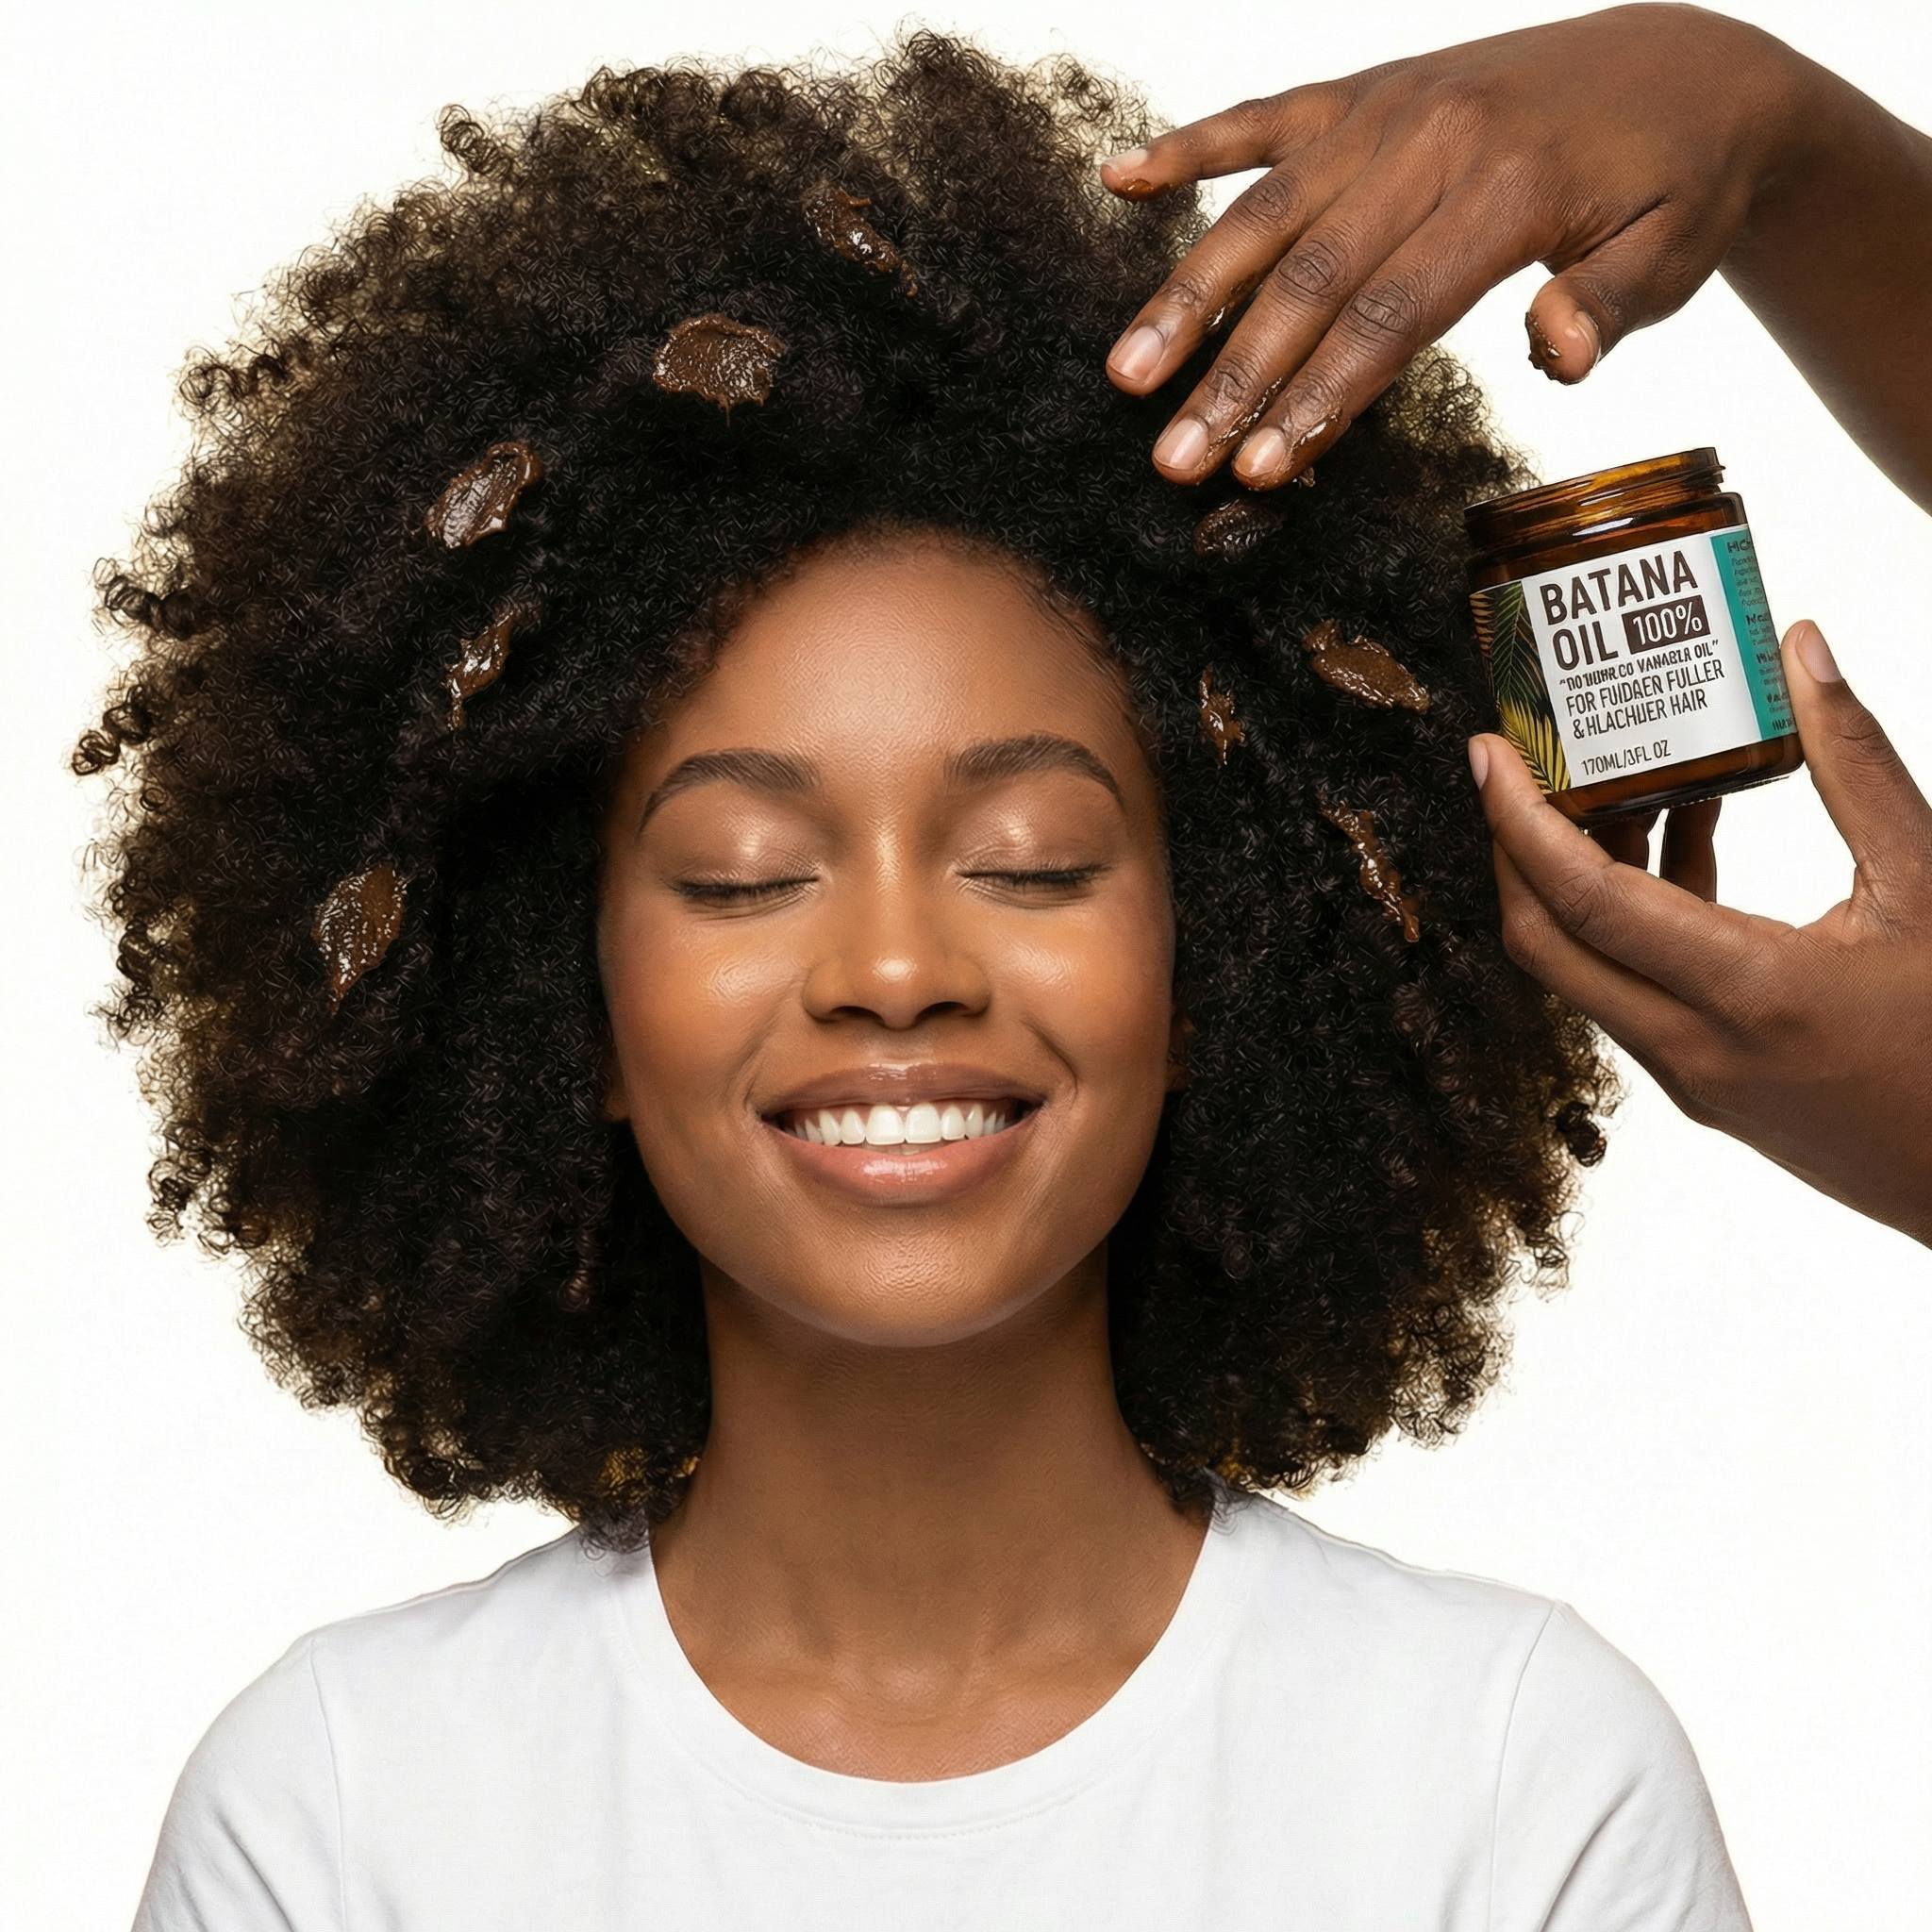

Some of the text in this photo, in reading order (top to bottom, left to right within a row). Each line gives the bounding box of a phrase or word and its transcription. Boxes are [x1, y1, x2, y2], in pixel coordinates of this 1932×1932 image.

[1540, 550, 1698, 625] BATANA
[1552, 621, 1619, 671] OIL
[1632, 601, 1703, 645] 100%
[1566, 691, 1597, 717] FOR
[1666, 658, 1725, 691] FULLER
[1573, 718, 1585, 740] &
[1670, 689, 1708, 716] HAIR
[1653, 739, 1672, 759] OZ
